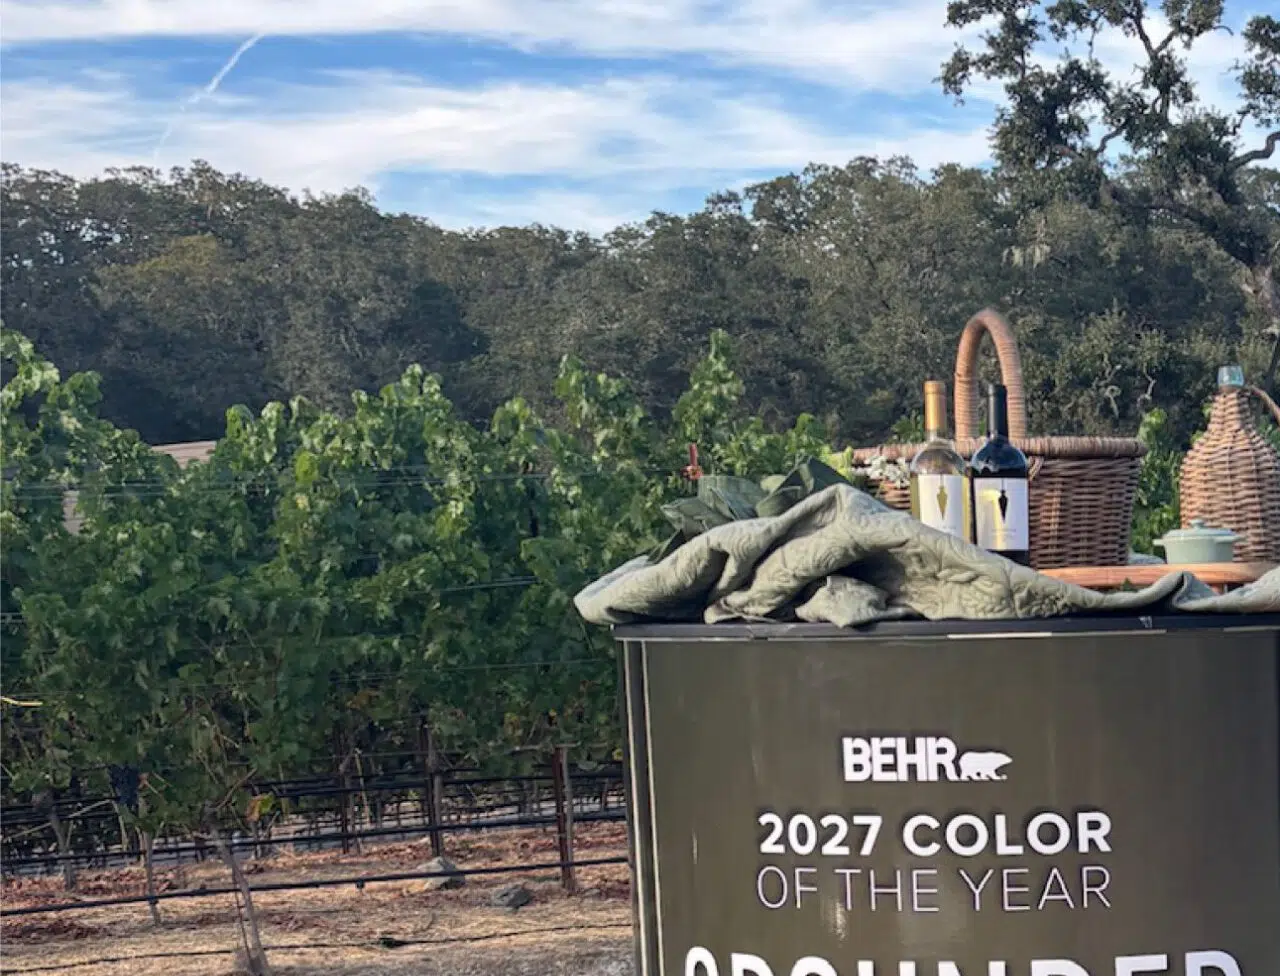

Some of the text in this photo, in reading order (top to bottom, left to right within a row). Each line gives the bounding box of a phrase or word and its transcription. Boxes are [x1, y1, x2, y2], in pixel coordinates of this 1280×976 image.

[842, 737, 958, 782] BEHR
[758, 811, 1112, 856] 2027 COLOR
[757, 865, 1111, 911] OF THE YEAR
